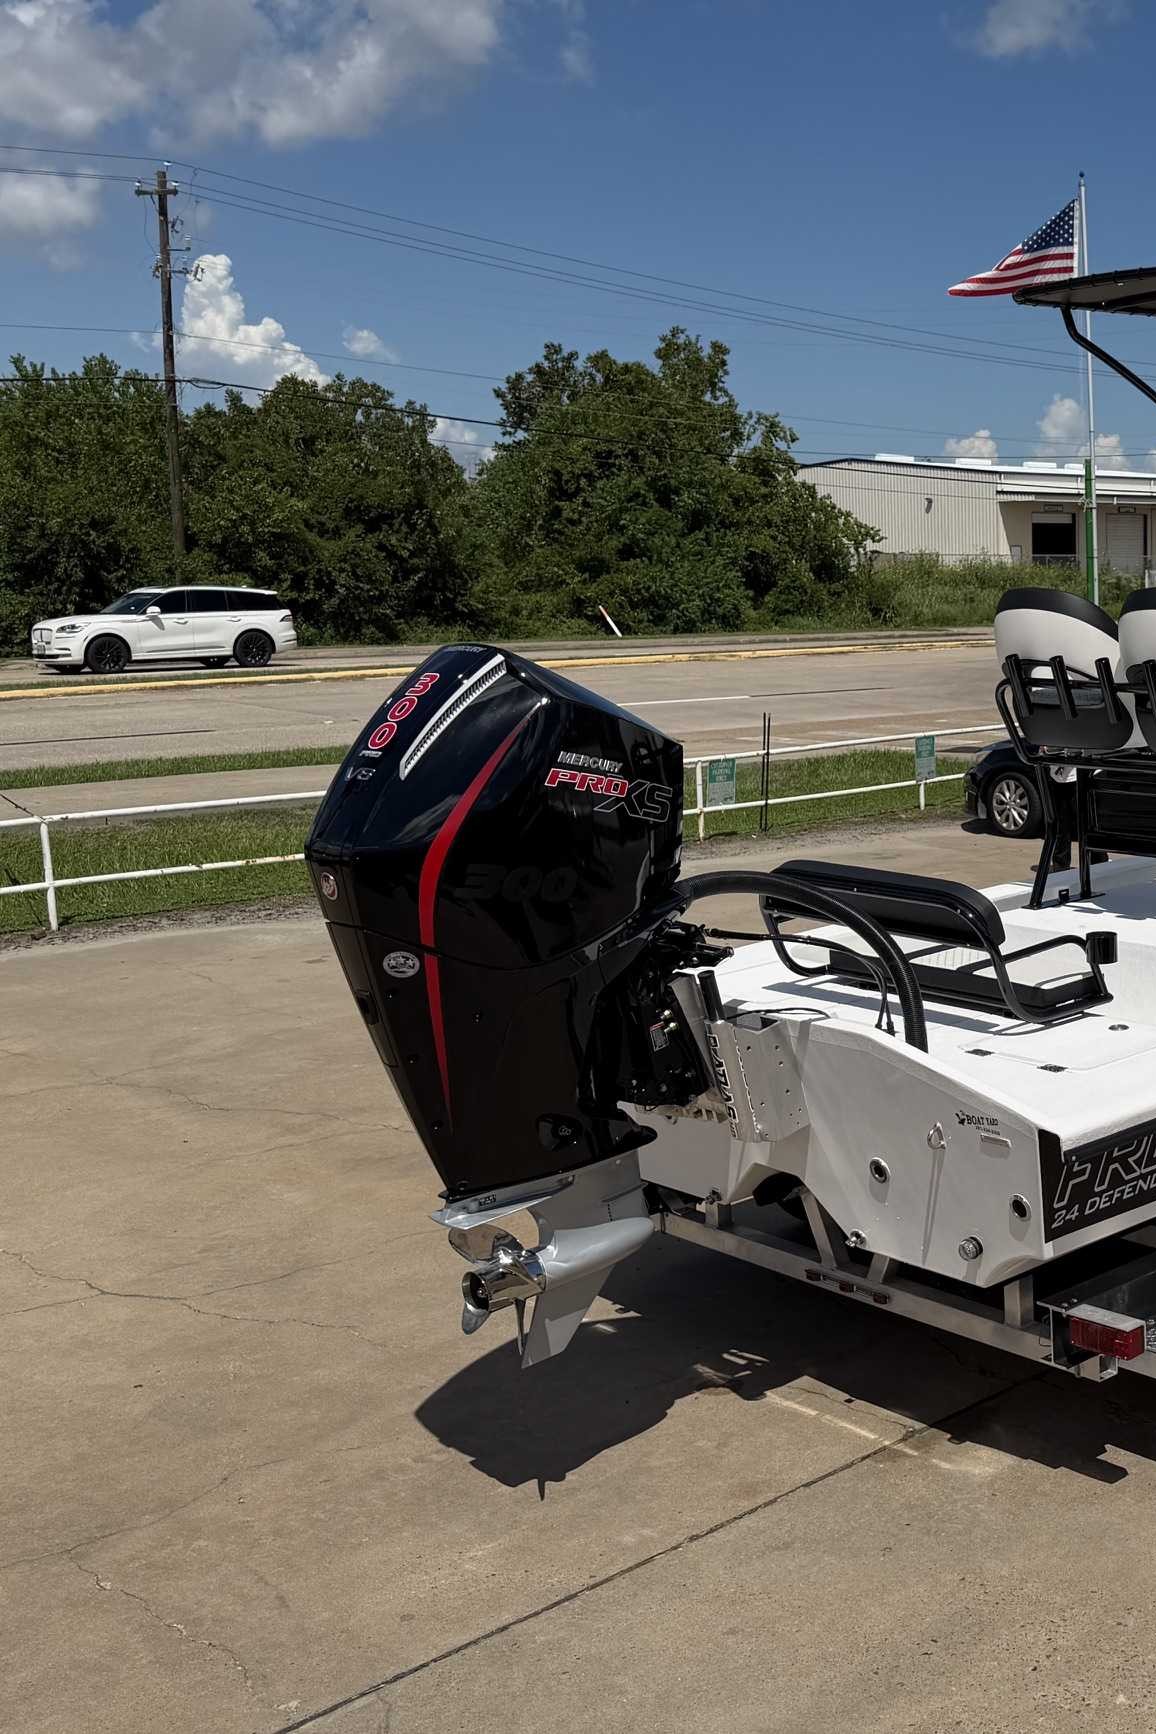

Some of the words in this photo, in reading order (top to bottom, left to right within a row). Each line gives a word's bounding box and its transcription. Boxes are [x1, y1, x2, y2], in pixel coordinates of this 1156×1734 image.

[368, 672, 440, 750] 300
[557, 750, 623, 773] MERCURY
[966, 1114, 984, 1125] BOAT
[1051, 1208, 1080, 1230] 24
